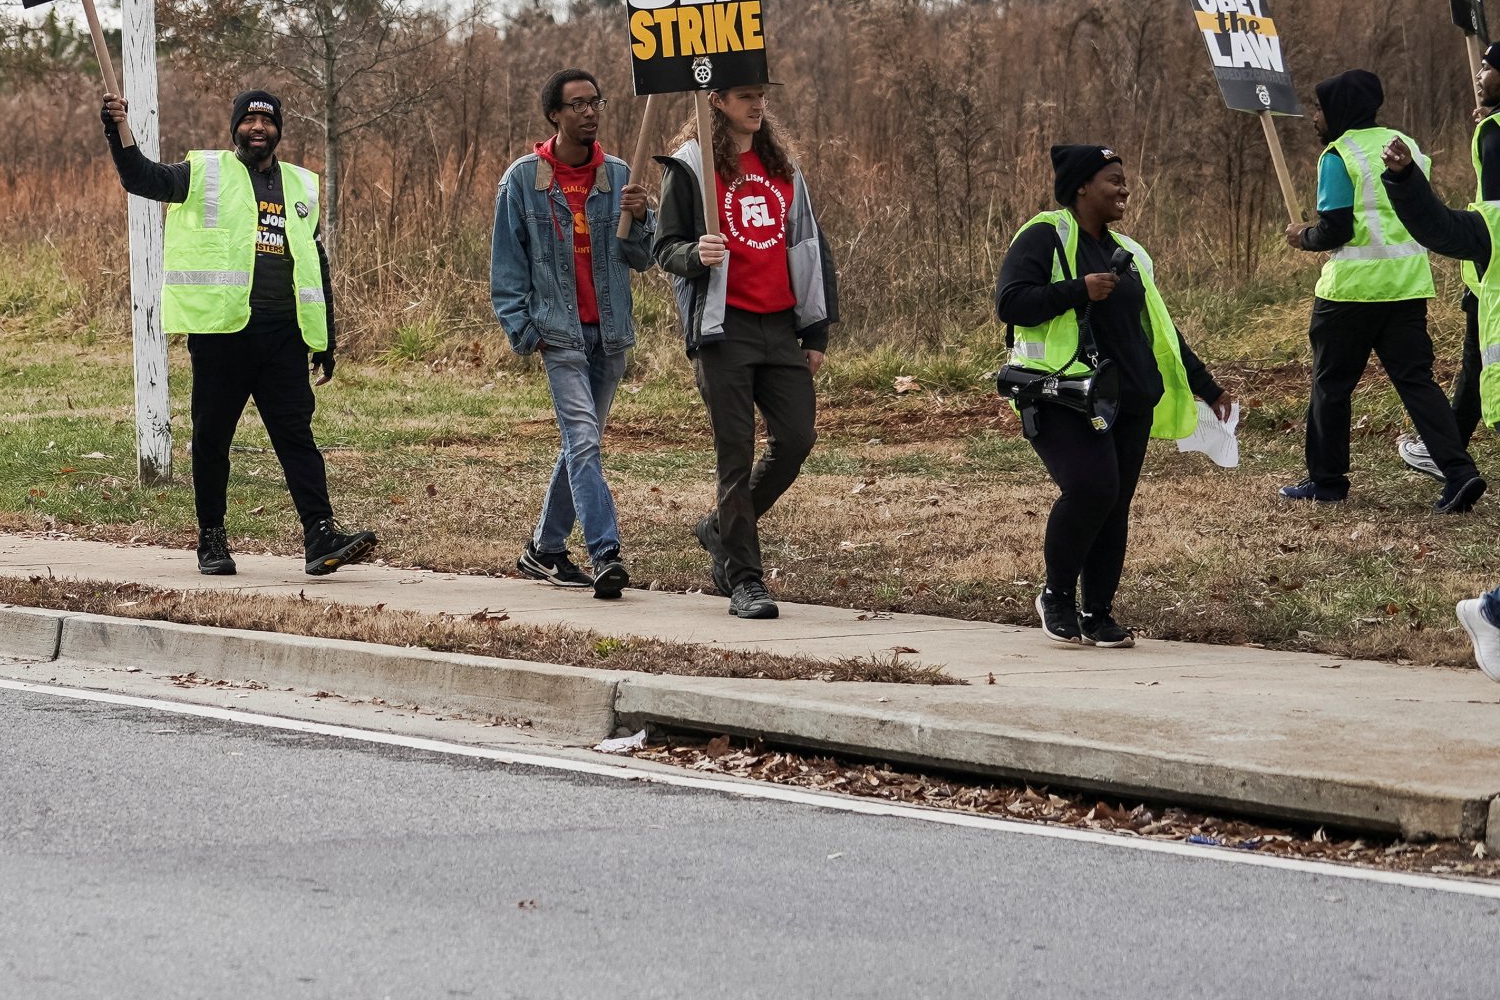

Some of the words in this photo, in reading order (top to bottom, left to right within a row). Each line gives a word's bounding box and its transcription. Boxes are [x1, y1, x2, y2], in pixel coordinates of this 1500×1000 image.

[630, 0, 765, 61] STRIKE
[1215, 10, 1263, 35] the
[1202, 29, 1285, 73] LAW
[250, 101, 274, 112] AMAZON
[259, 200, 283, 215] PAY
[724, 191, 734, 209] FOR
[740, 200, 776, 228] PSL
[746, 237, 779, 250] ATLANTA
